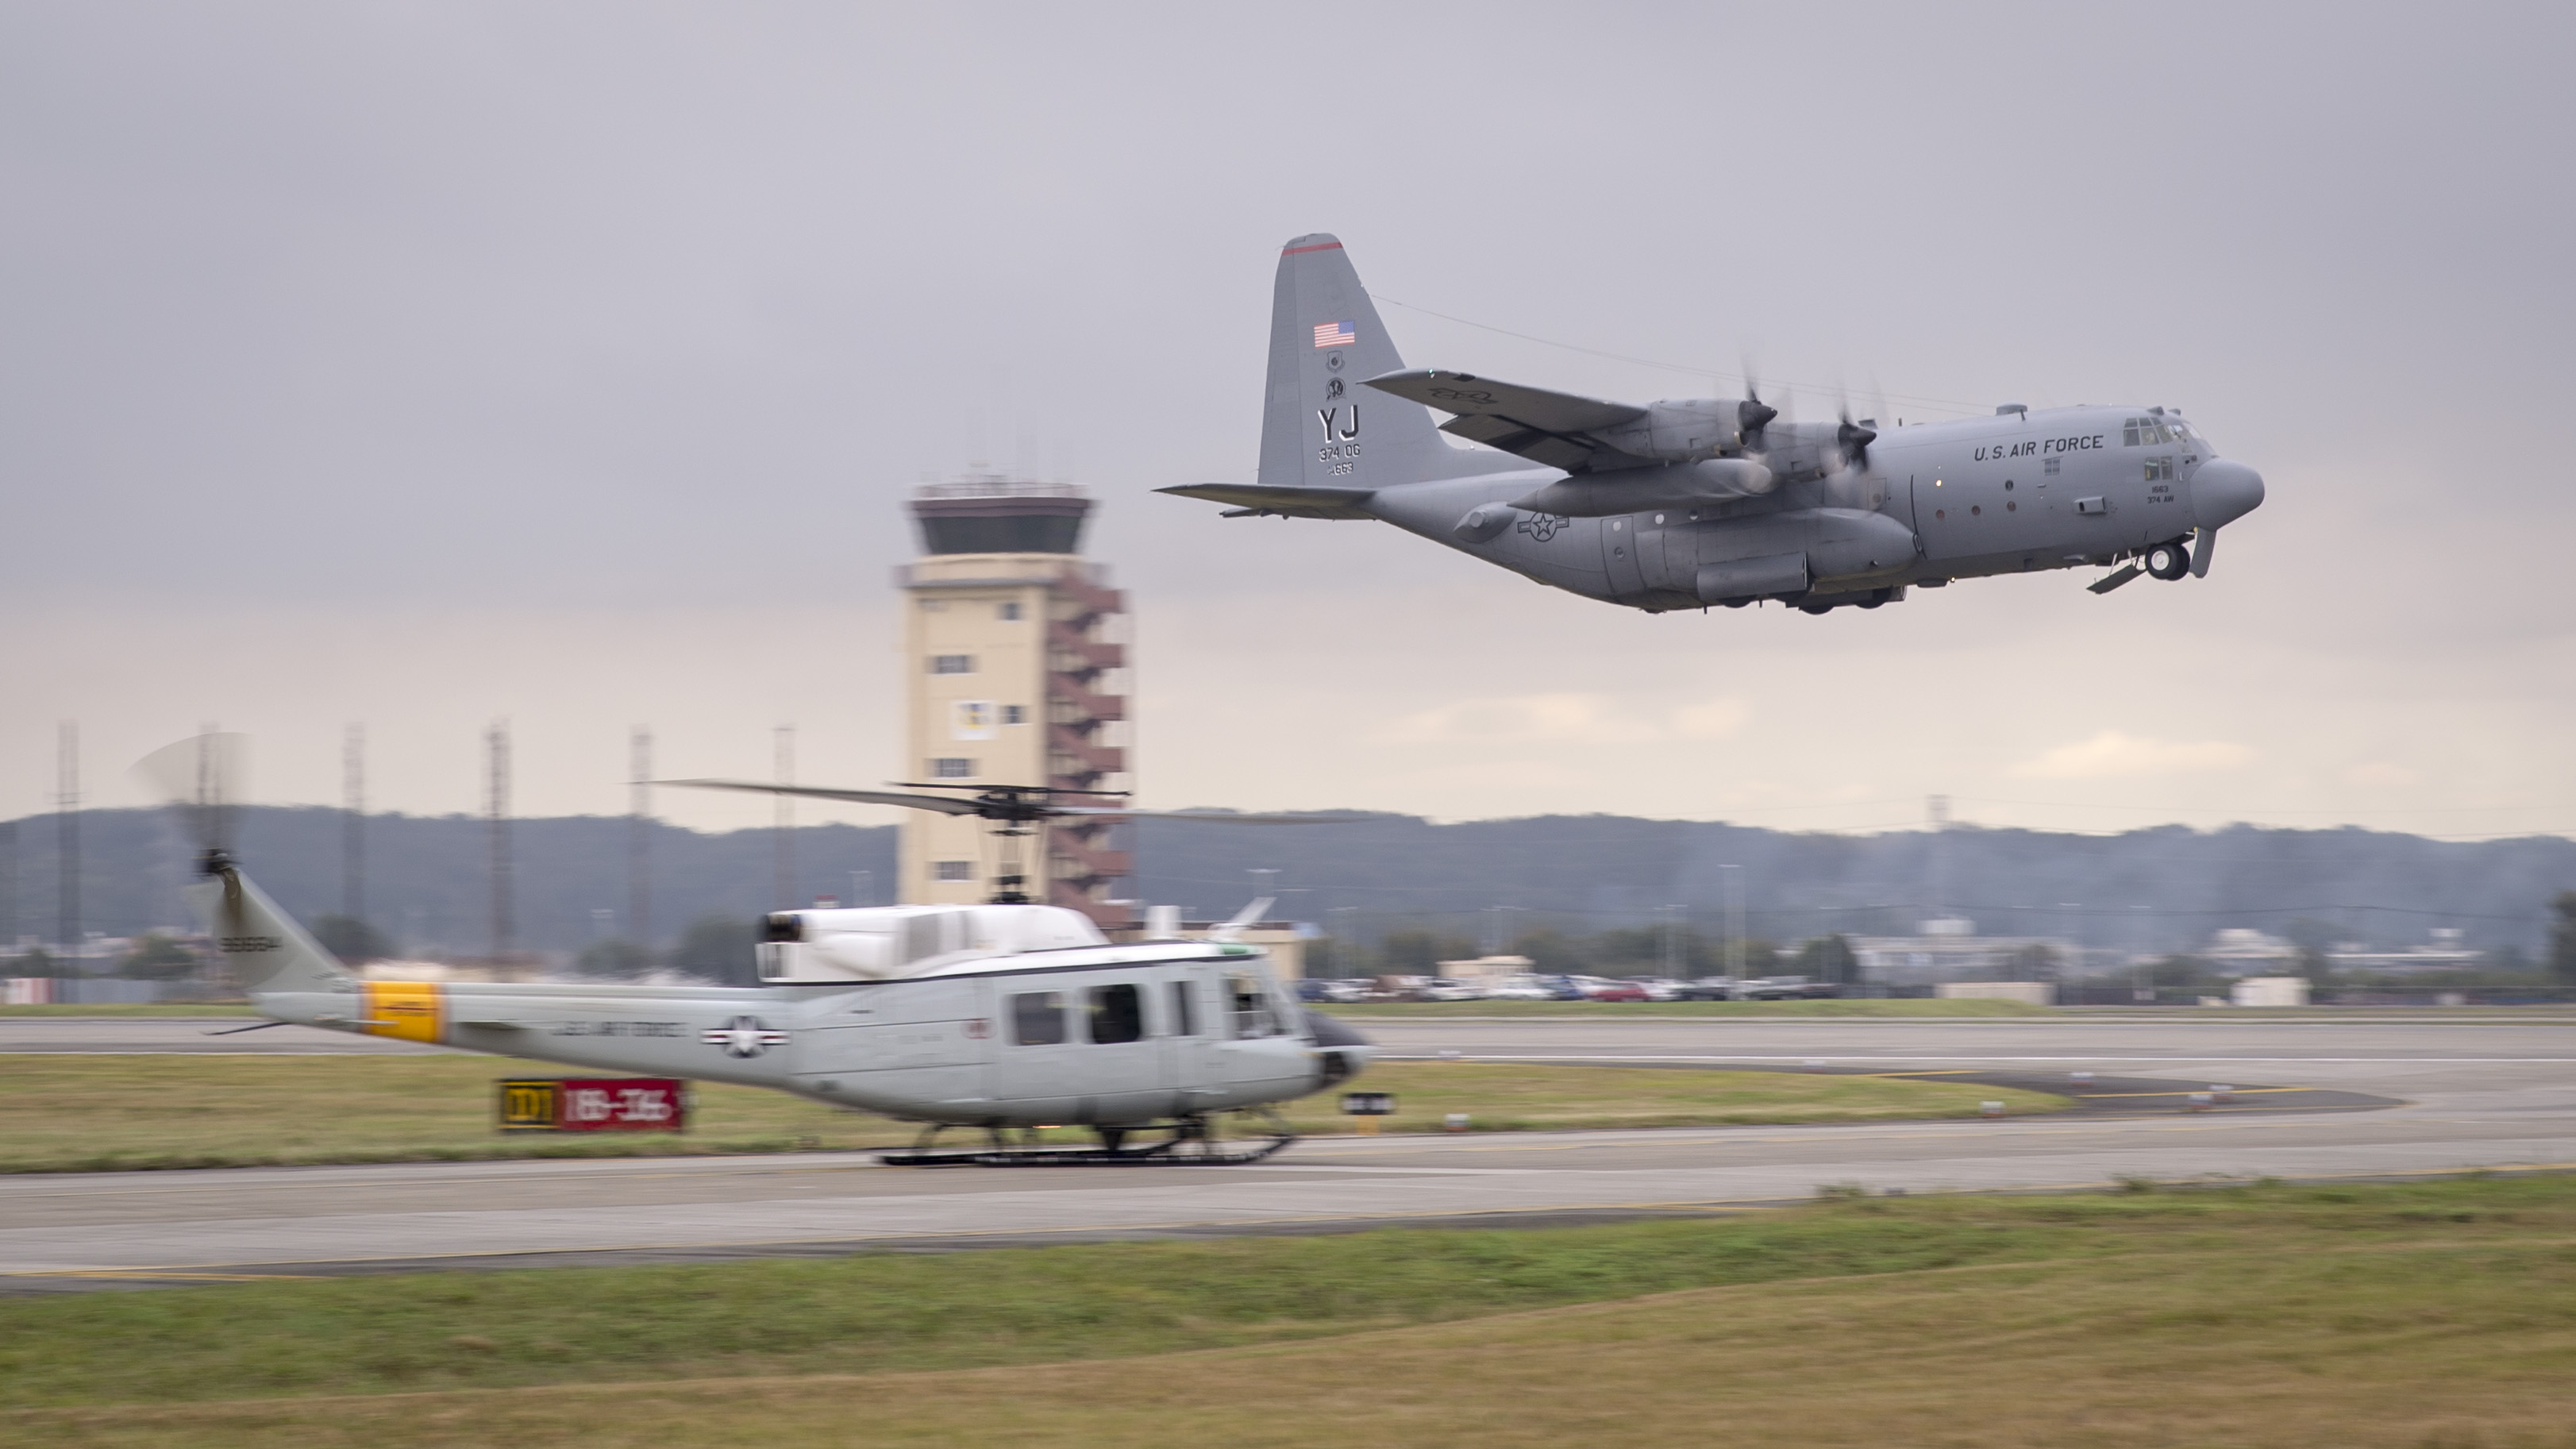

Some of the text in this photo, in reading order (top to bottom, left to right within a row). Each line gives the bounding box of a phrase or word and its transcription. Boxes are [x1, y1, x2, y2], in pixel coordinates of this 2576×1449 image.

[1318, 404, 1359, 444] YJ
[1319, 446, 1340, 462] 374
[1974, 435, 2104, 461] U.S. AIR FORCE
[2147, 495, 2161, 504] 374
